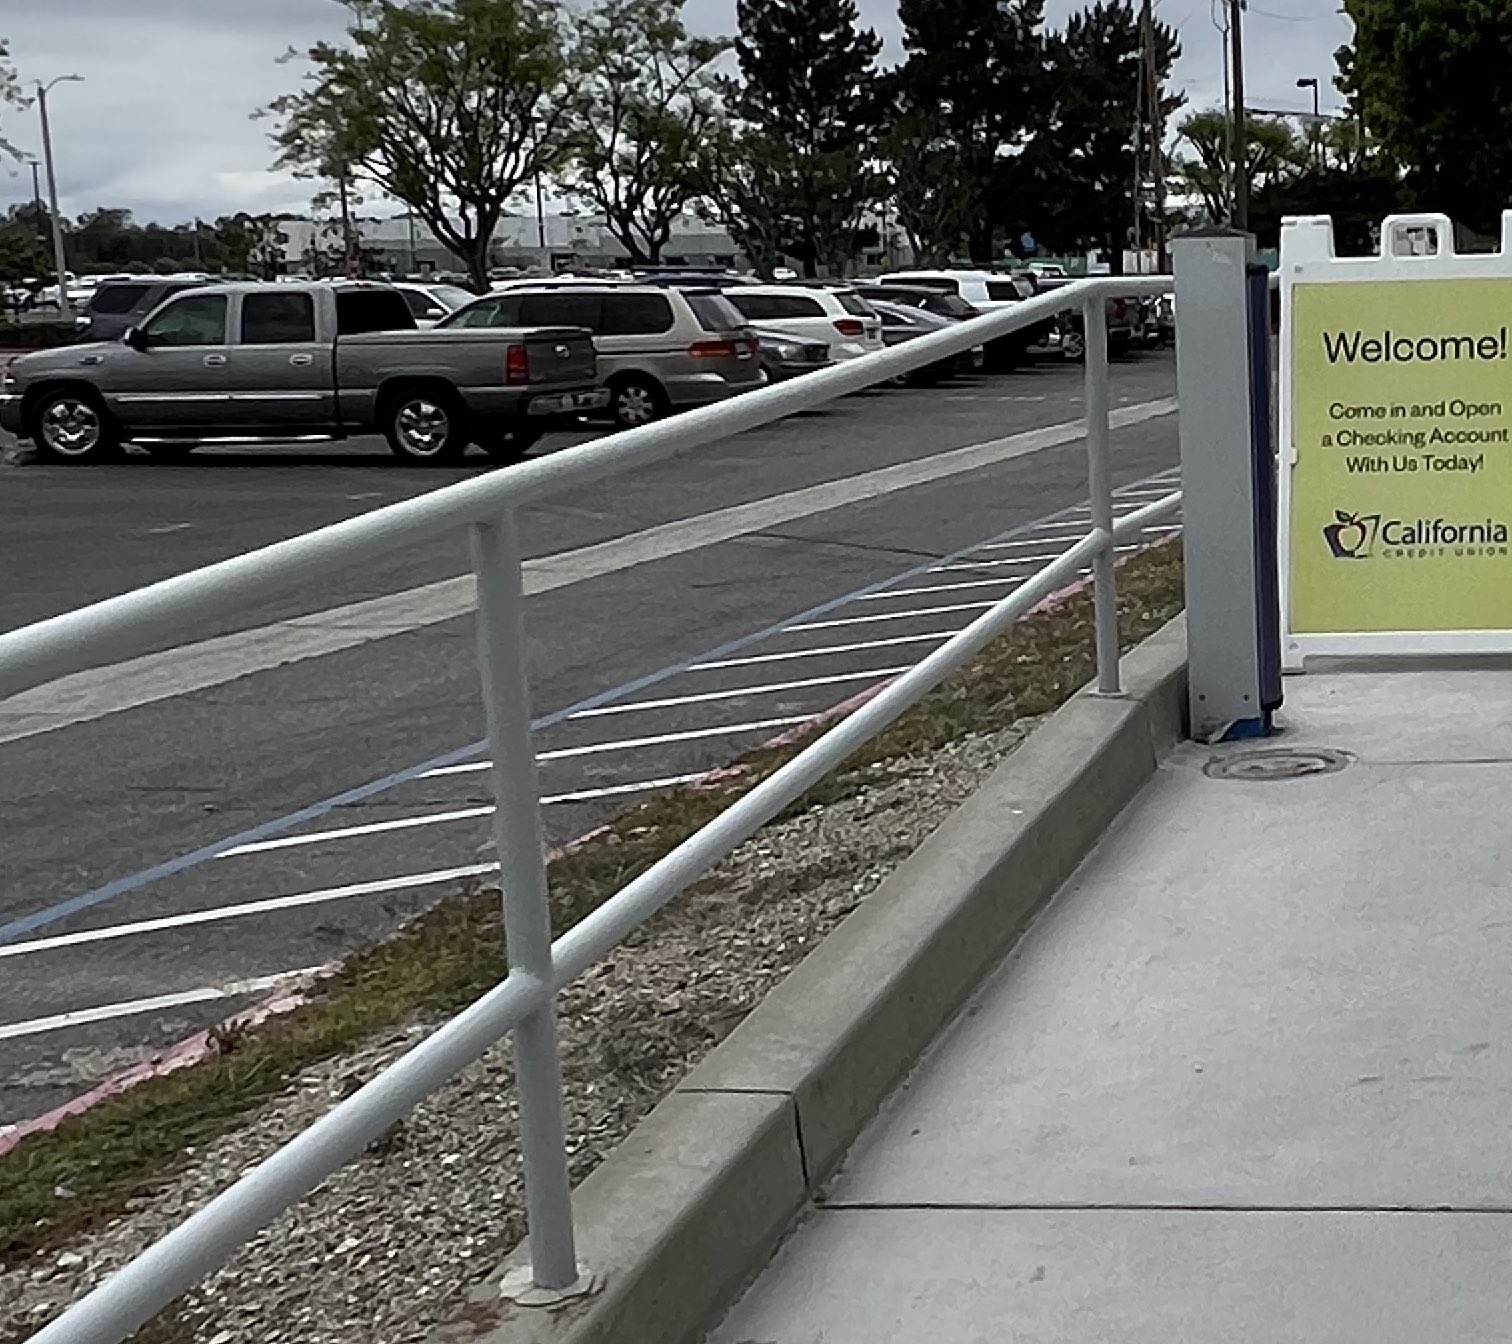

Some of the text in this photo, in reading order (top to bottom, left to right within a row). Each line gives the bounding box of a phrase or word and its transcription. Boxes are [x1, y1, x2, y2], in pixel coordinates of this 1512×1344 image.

[1322, 327, 1507, 364] Welcome!
[1329, 399, 1502, 420] Come in and Open
[1321, 427, 1510, 449] a Checking Account
[1346, 454, 1484, 473] With Us Today!
[1382, 518, 1508, 546] California
[1382, 547, 1508, 558] CREDIT UNION
